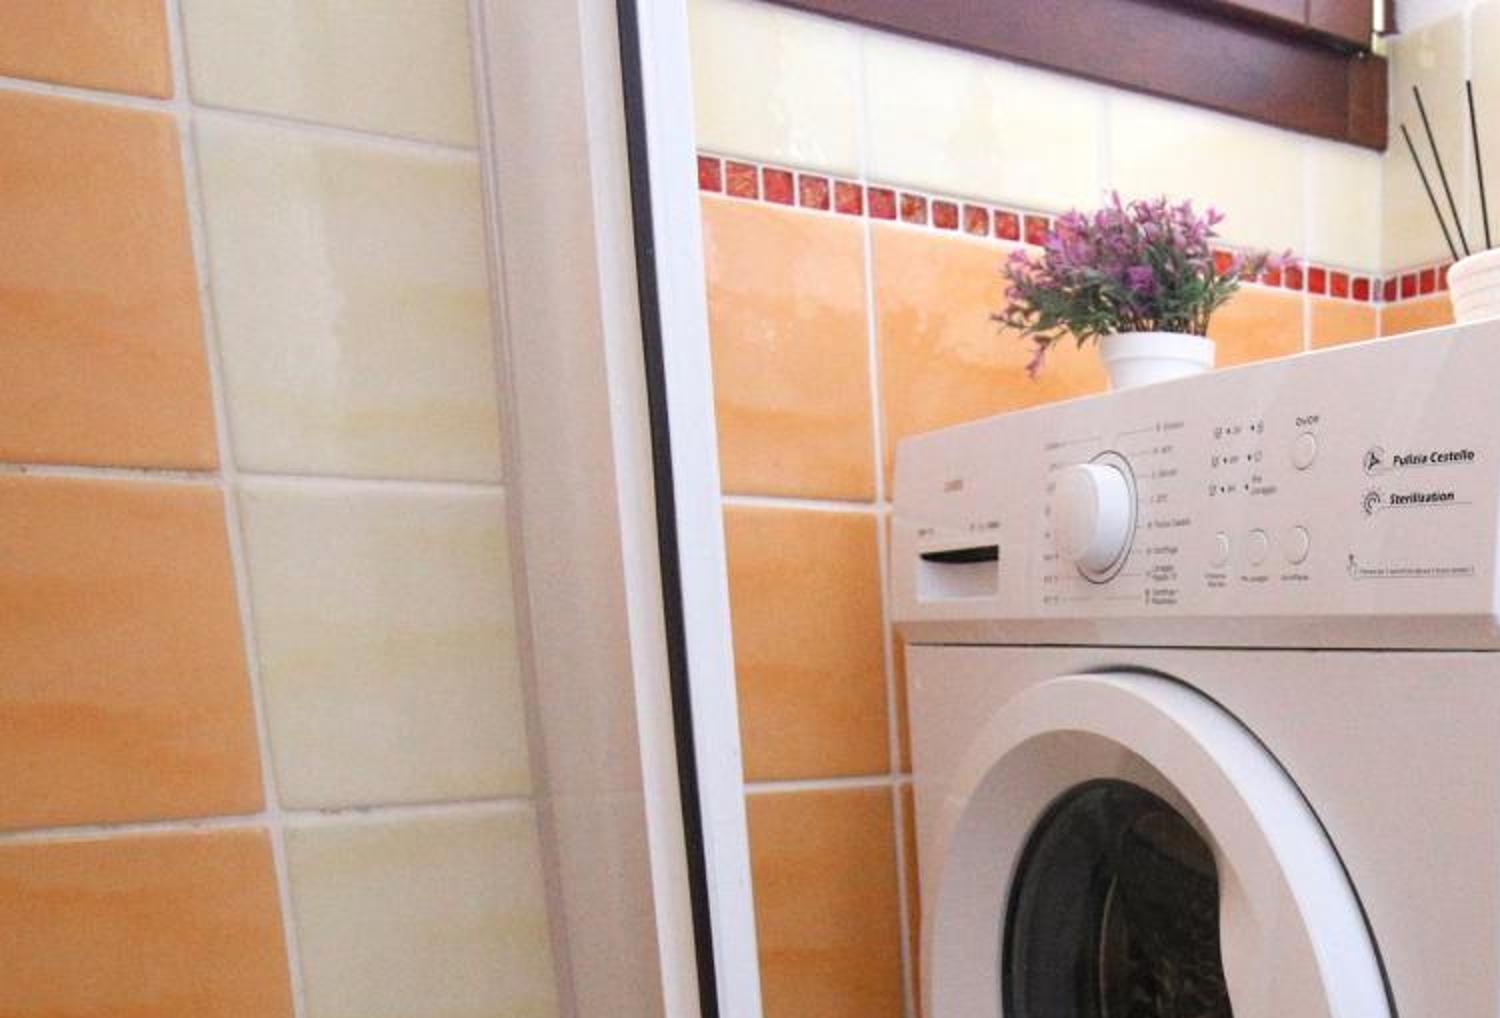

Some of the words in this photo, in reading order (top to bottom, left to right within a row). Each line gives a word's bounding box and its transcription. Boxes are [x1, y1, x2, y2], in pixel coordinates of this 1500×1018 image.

[1393, 453, 1427, 467] Pulizia
[1430, 450, 1475, 464] Cestello
[1390, 491, 1455, 505] Sterilization
